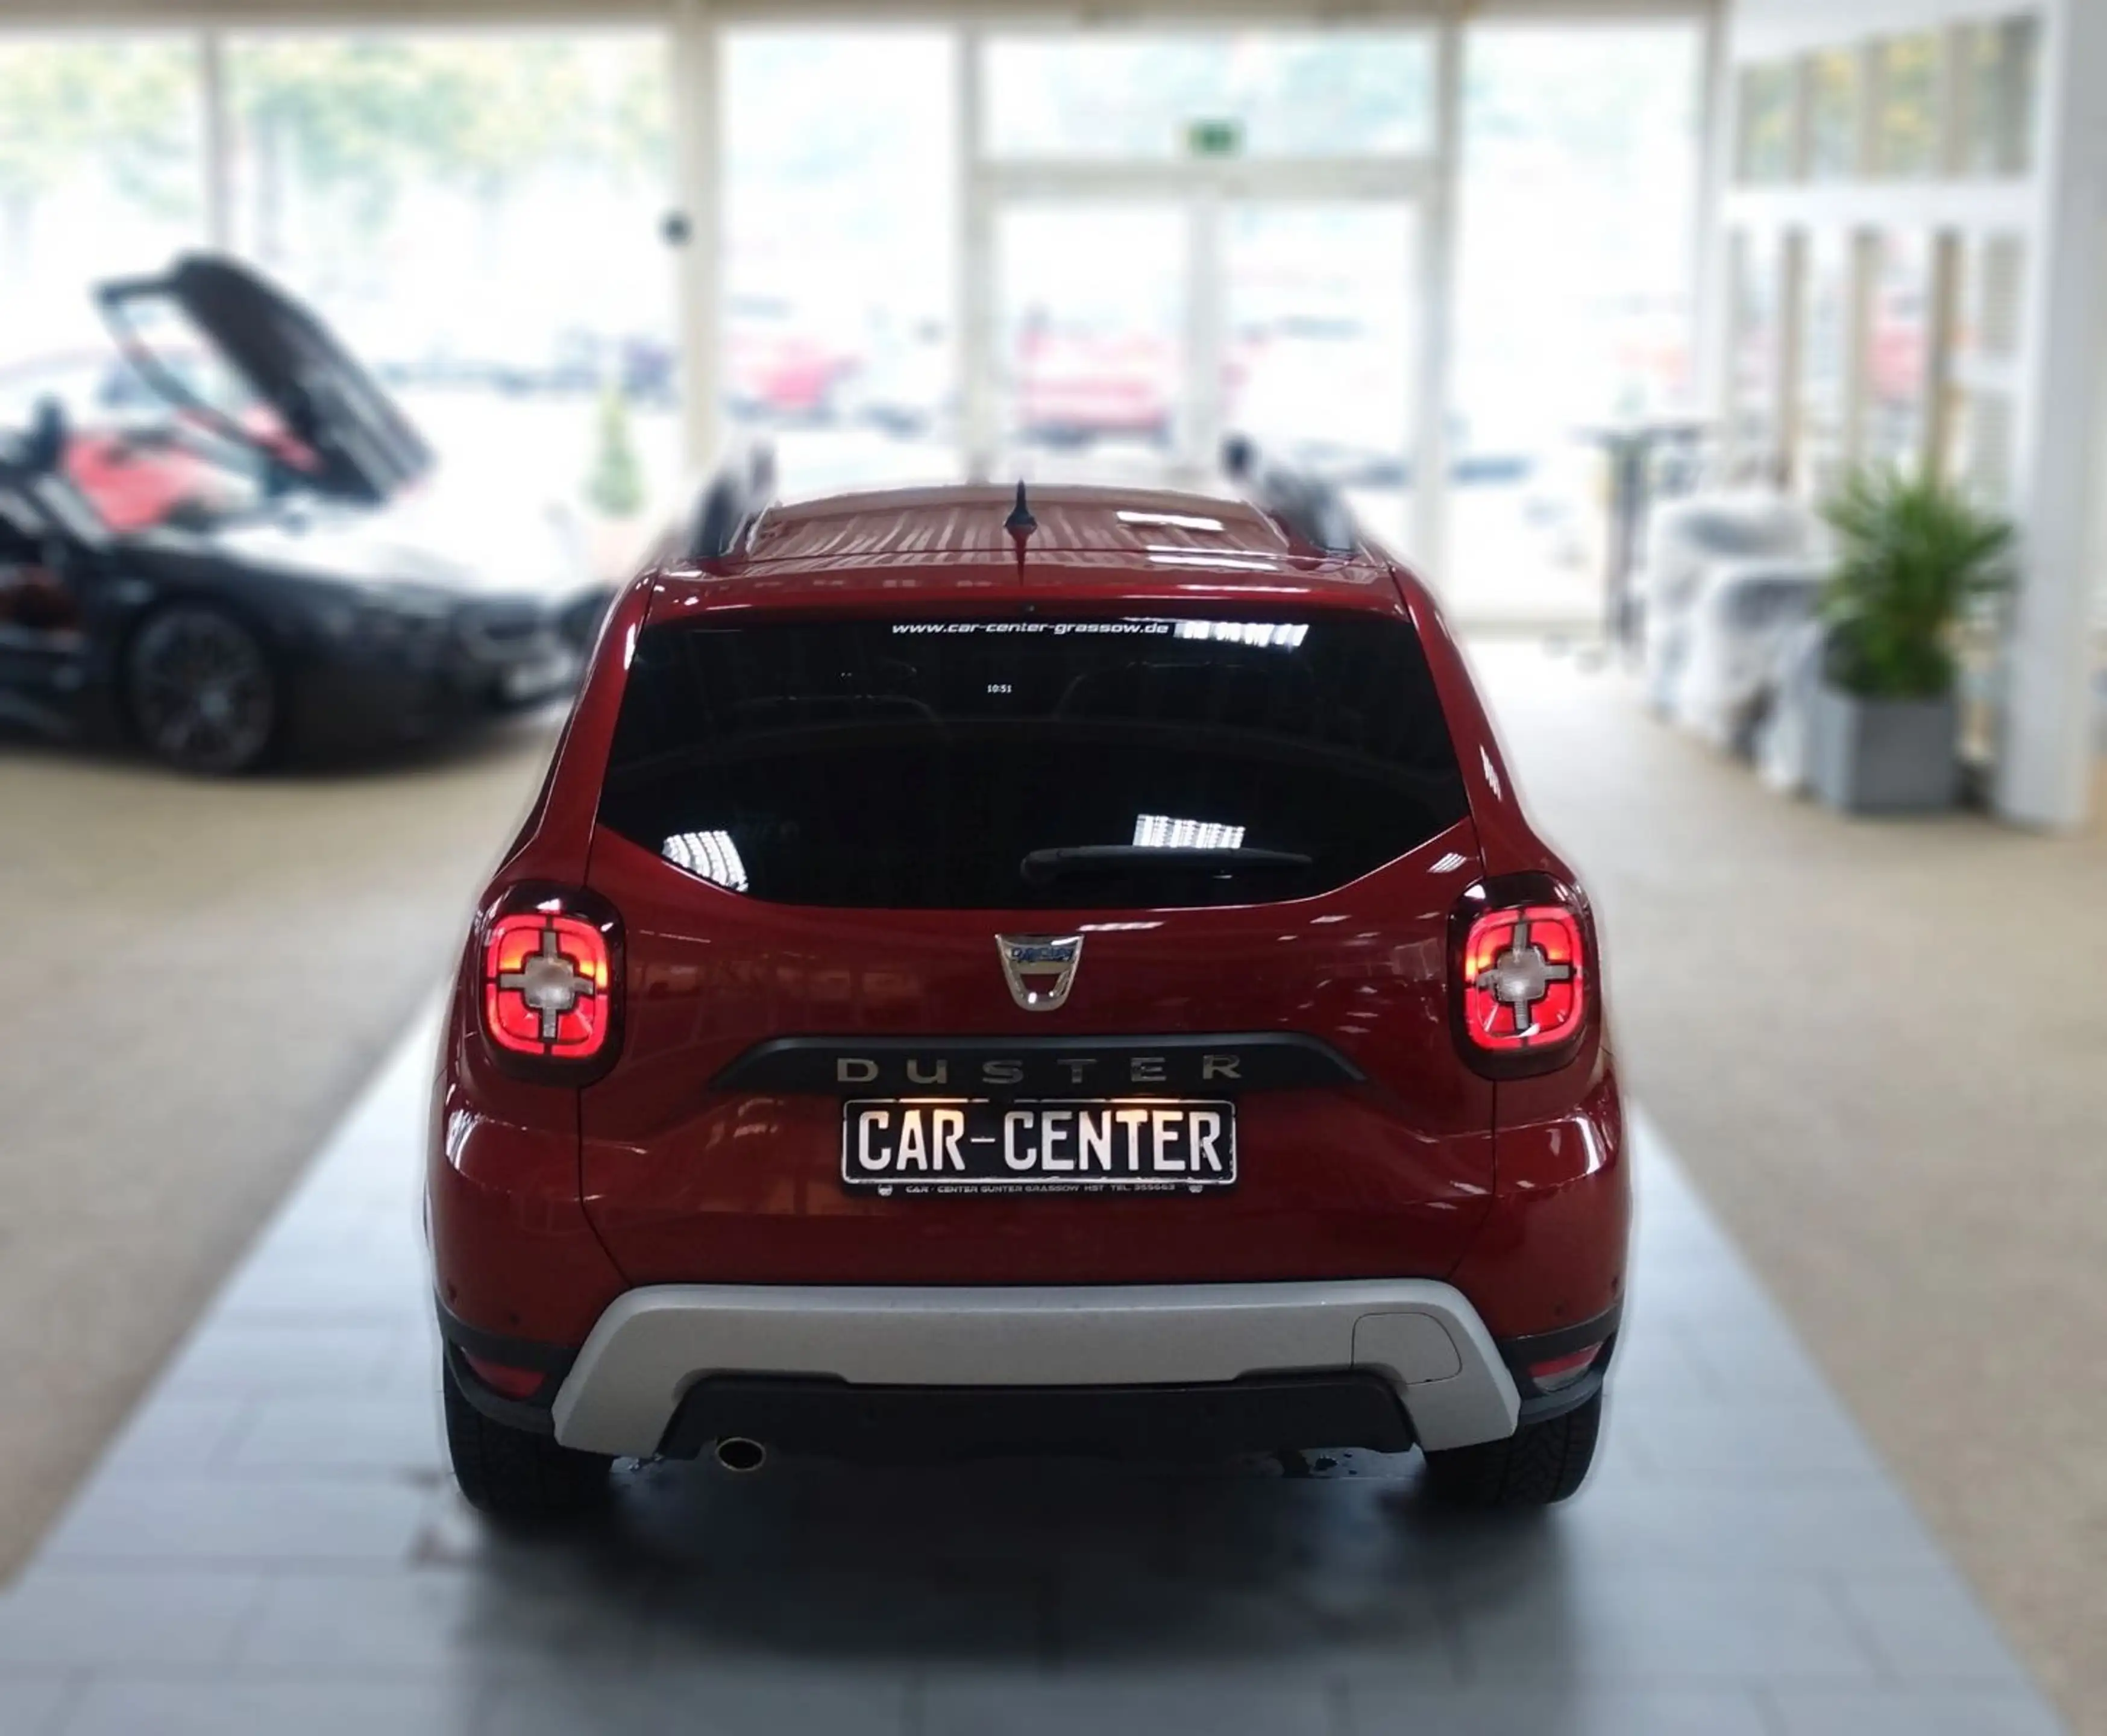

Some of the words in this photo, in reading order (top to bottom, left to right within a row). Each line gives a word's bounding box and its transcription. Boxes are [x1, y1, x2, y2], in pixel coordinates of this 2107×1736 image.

[892, 623, 1169, 634] www.car-center-grassow.de
[837, 1055, 1242, 1084] DUSTER
[858, 1109, 1223, 1172] CAR-CENTER
